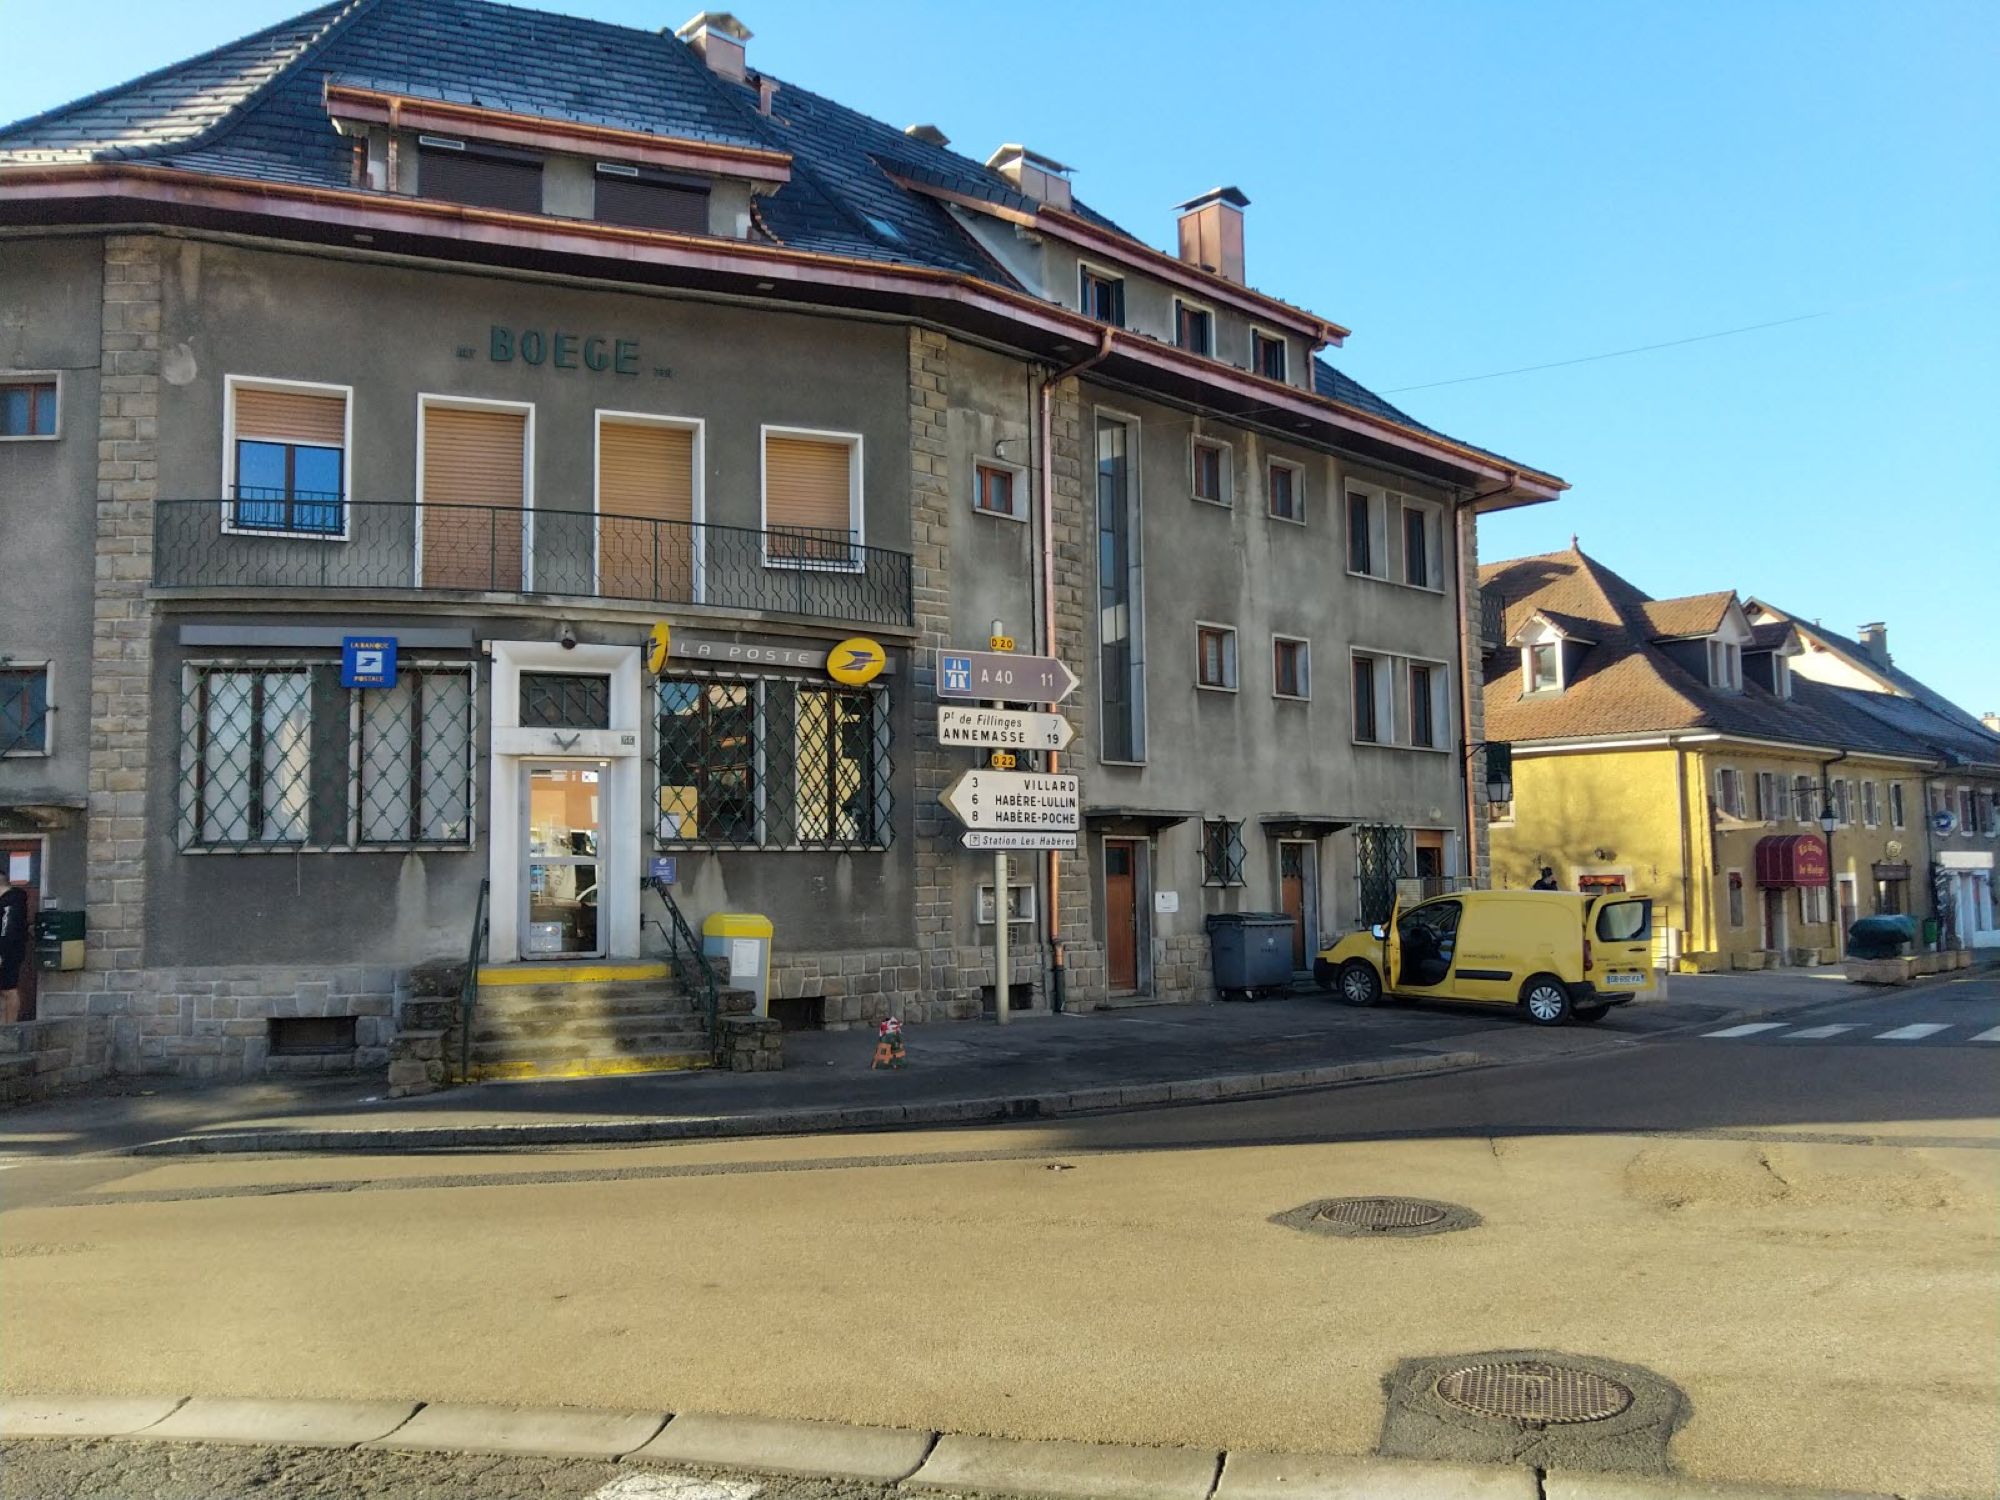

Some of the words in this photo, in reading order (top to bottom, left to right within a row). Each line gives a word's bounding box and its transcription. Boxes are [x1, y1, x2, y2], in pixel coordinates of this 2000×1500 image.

[490, 325, 641, 376] BOEGE
[992, 638, 997, 647] D
[1000, 640, 1013, 649] 20
[680, 642, 711, 656] LA
[729, 646, 809, 664] POSTE
[981, 669, 989, 683] A
[995, 670, 1013, 685] 40
[1040, 673, 1054, 687] 11
[959, 714, 971, 725] de
[976, 714, 1022, 730] Fillinges
[943, 728, 1026, 743] ANNEMASSE
[1046, 734, 1059, 744] 19
[993, 756, 999, 765] D
[1001, 756, 1014, 766] 22
[971, 777, 978, 788] 3
[1024, 779, 1076, 792] VILLARD
[971, 794, 978, 805] 6
[995, 793, 1076, 808] HABÈRE-LULLIN
[971, 810, 978, 822] 8
[995, 810, 1076, 825] HABÈRE-POCHE
[983, 835, 1017, 846] Station
[1020, 836, 1035, 846] Les
